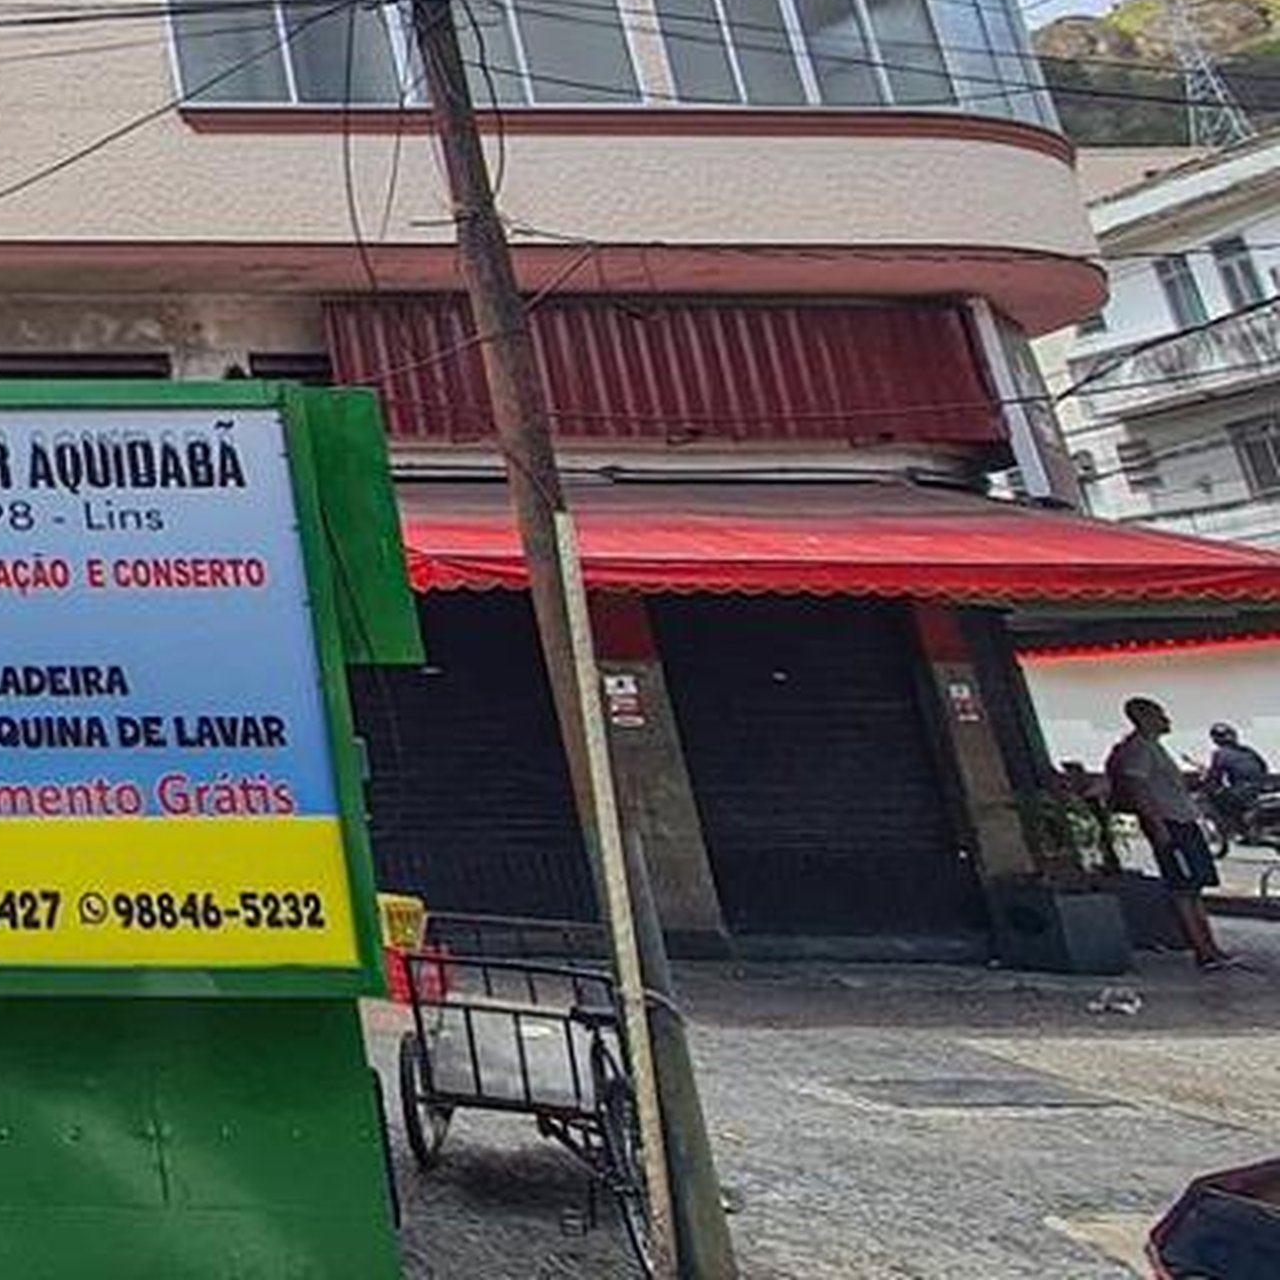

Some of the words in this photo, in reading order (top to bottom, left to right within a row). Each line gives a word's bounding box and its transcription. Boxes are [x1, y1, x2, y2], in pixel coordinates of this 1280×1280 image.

[29, 421, 246, 495] AQUIDABÃ
[84, 500, 165, 532] Lins
[87, 559, 107, 588] E
[114, 558, 266, 588] CONSERTO
[117, 717, 168, 748] DE
[175, 717, 287, 748] LAVAR
[157, 772, 295, 818] Grátis
[112, 891, 326, 930] 98846-5232
